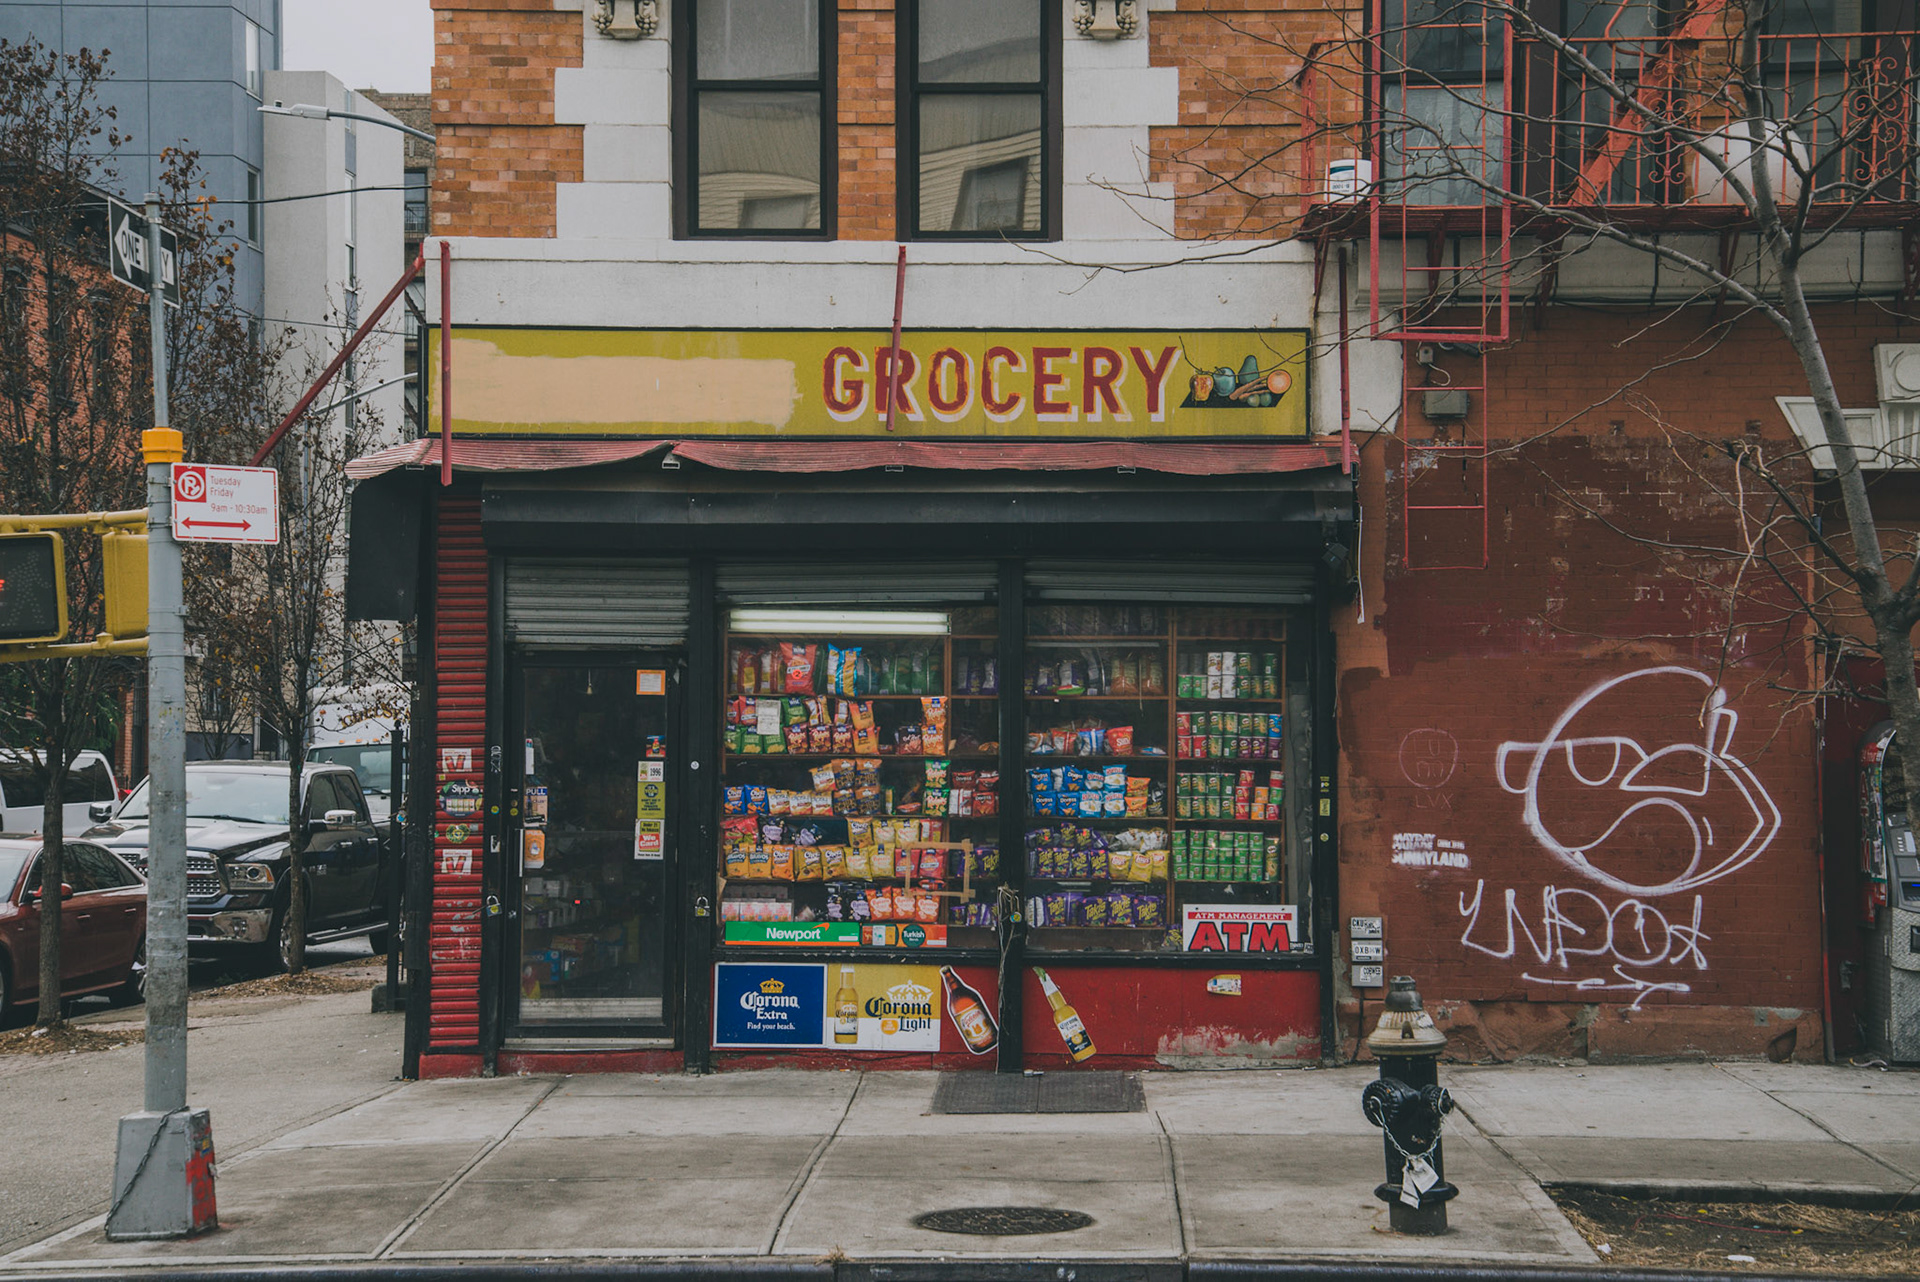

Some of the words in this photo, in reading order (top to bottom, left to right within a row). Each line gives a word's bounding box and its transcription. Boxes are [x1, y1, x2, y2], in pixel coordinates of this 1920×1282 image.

[122, 230, 141, 266] ONE
[822, 346, 1181, 421] GROCERY
[210, 475, 241, 486] Tuesday
[210, 487, 234, 498] Friday
[210, 503, 228, 512] 9am
[235, 504, 268, 515] 10:30am
[650, 767, 661, 777] 1996
[452, 784, 471, 796] Sipp
[525, 788, 546, 796] PULL
[1194, 912, 1216, 920] ATM
[1218, 913, 1287, 921] MANAGEMENT
[765, 927, 821, 941] Newport
[903, 930, 925, 938] Turkish
[1188, 921, 1291, 952] ATM
[740, 991, 800, 1012] Corona
[756, 1007, 788, 1020] Extra
[865, 996, 932, 1020] Corona
[747, 1021, 761, 1030] Find
[762, 1023, 776, 1031] your
[776, 1021, 796, 1030] beach.
[898, 1016, 932, 1033] Light
